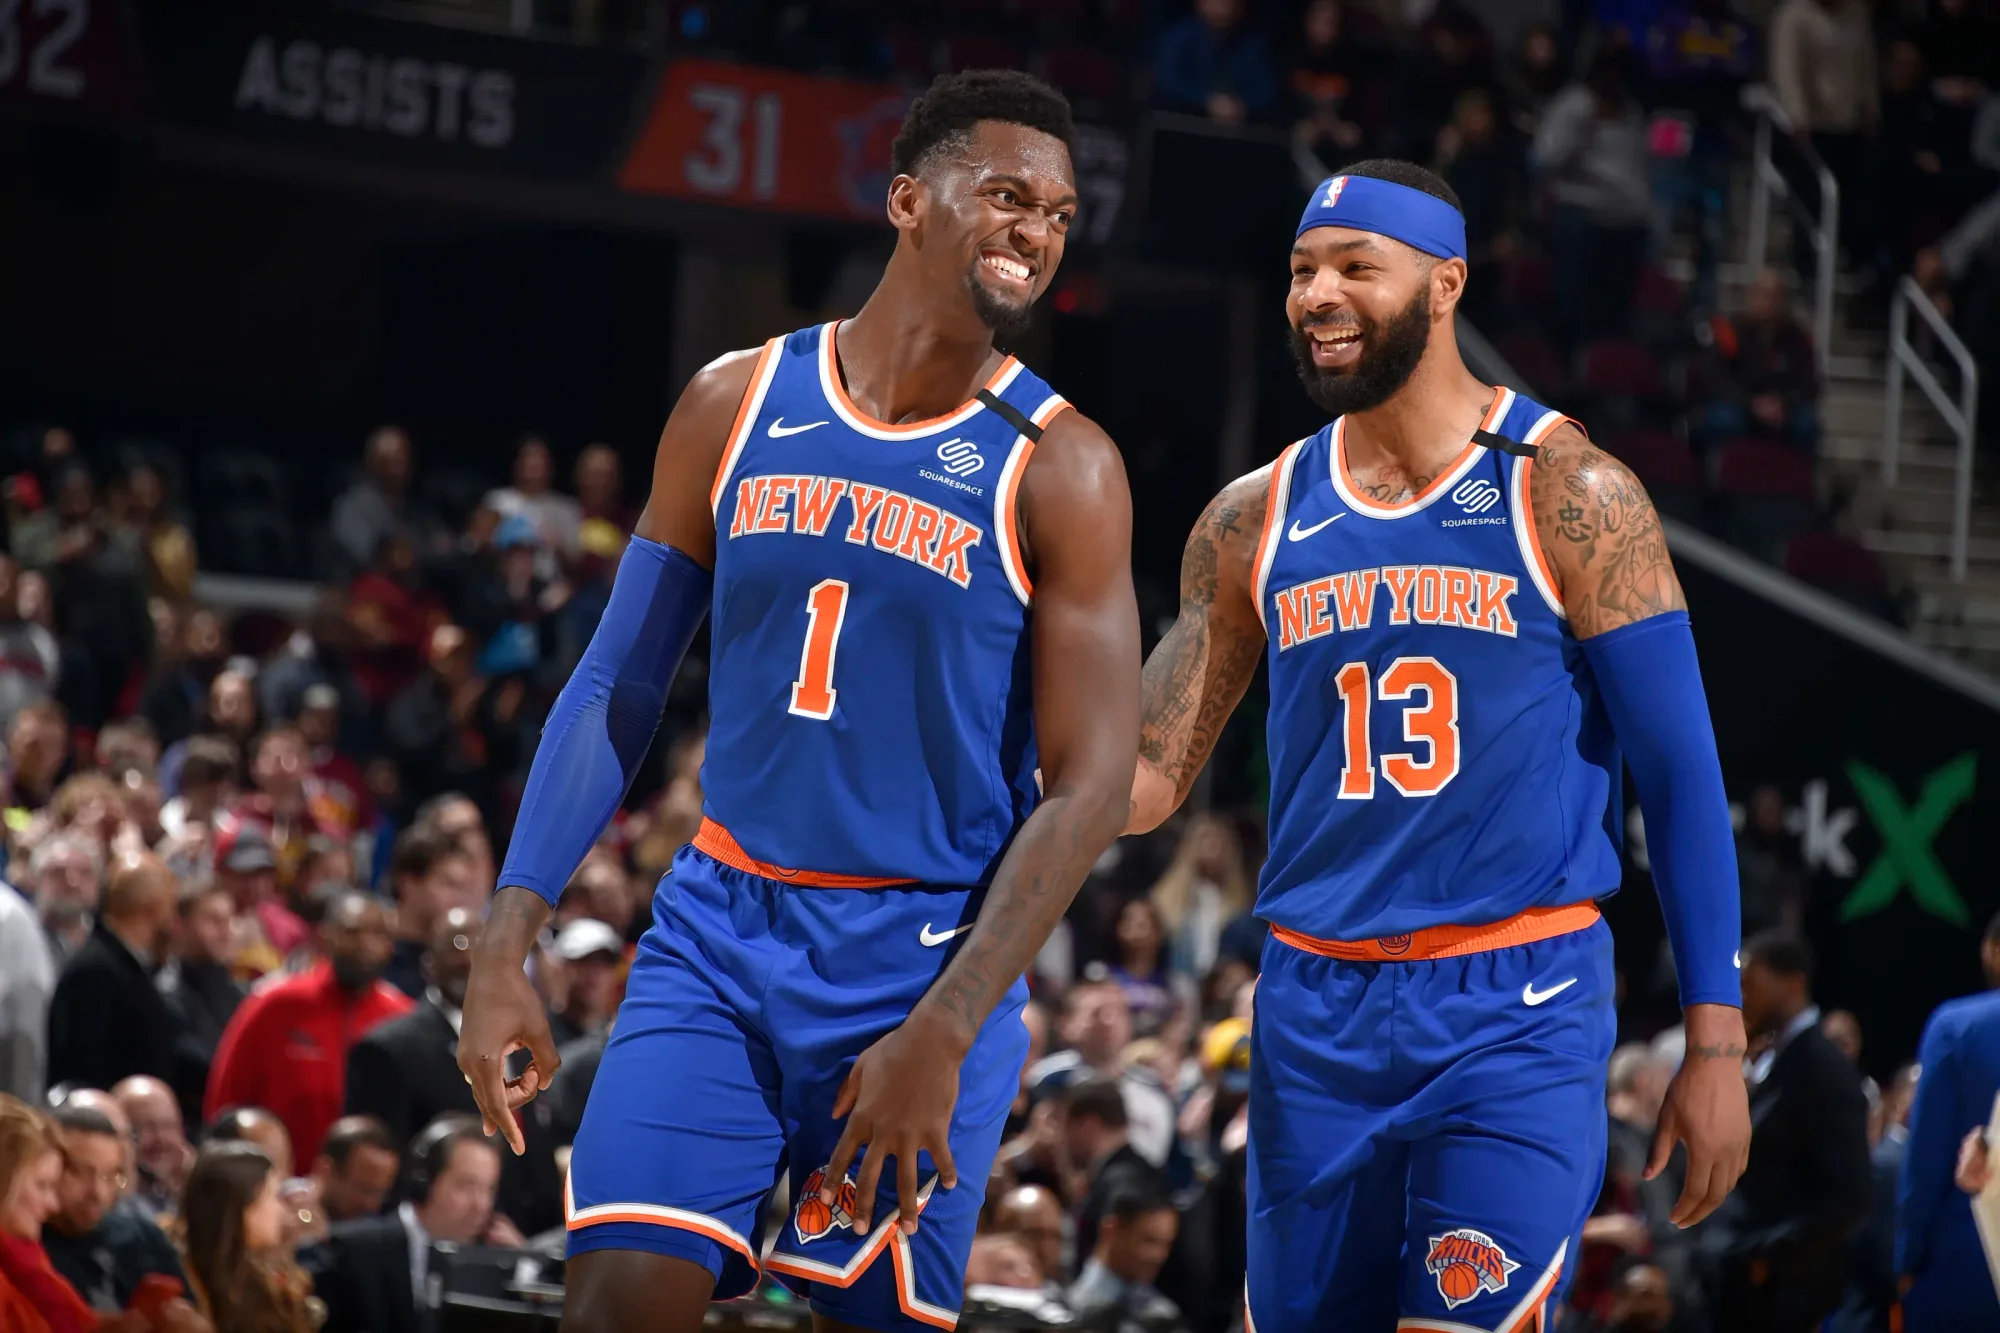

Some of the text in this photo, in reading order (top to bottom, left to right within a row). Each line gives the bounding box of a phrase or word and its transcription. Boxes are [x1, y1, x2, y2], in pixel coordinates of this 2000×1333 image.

[233, 33, 517, 148] ASSISTS
[682, 84, 783, 201] 31
[729, 474, 983, 590] NEW YORK
[918, 469, 984, 496] SQUARESPACE
[1441, 517, 1507, 528] SQUARESPACE
[788, 578, 849, 720] 1
[1273, 564, 1519, 653] NEW YORK
[1334, 656, 1461, 800] 13
[1427, 1235, 1505, 1286] KNICKS
